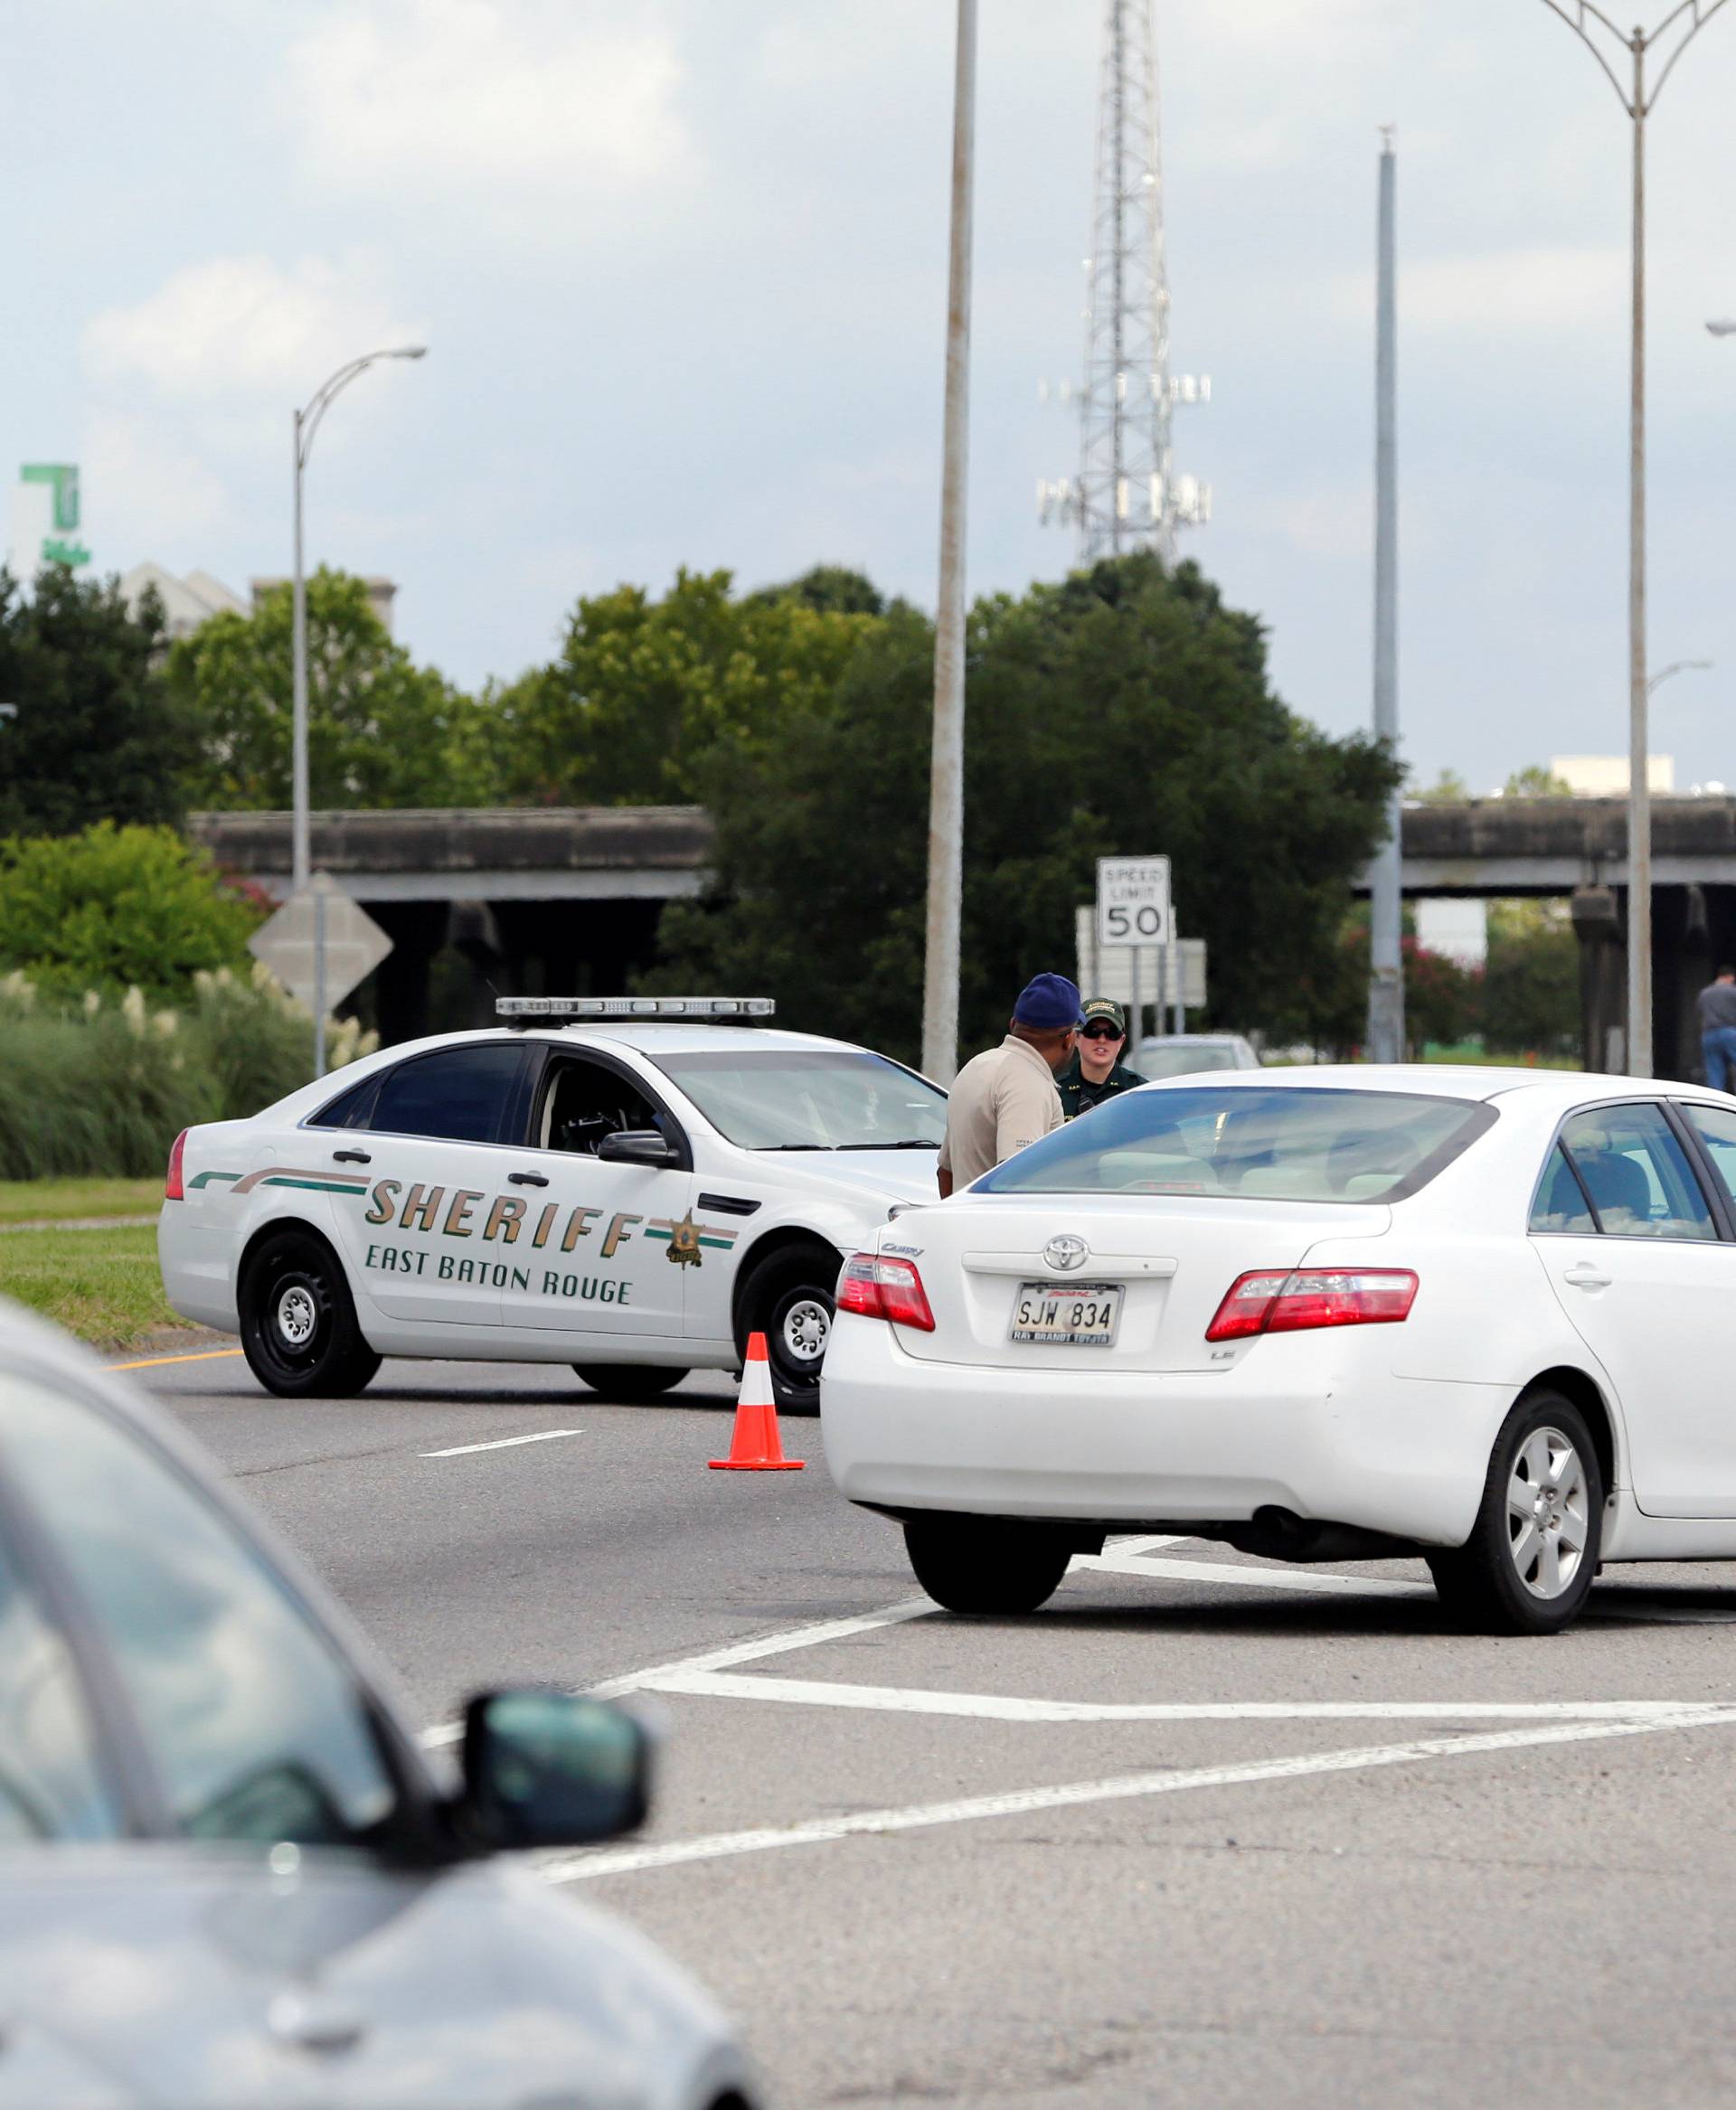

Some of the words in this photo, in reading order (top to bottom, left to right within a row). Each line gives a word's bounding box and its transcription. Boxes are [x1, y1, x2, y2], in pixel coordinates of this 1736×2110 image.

[1106, 868, 1163, 883] SPEED
[1110, 886, 1155, 900] LIMIT
[1109, 907, 1161, 936] 50
[364, 1178, 644, 1258] SHERIFF
[364, 1244, 430, 1276] EAST
[438, 1256, 531, 1291] BATON
[542, 1270, 634, 1305] ROUGE
[1018, 1300, 1059, 1325] SJW
[1071, 1303, 1111, 1329] 834
[1014, 1331, 1032, 1341] RAY
[1034, 1332, 1071, 1342] BRANDT
[1210, 1351, 1235, 1360] LE
